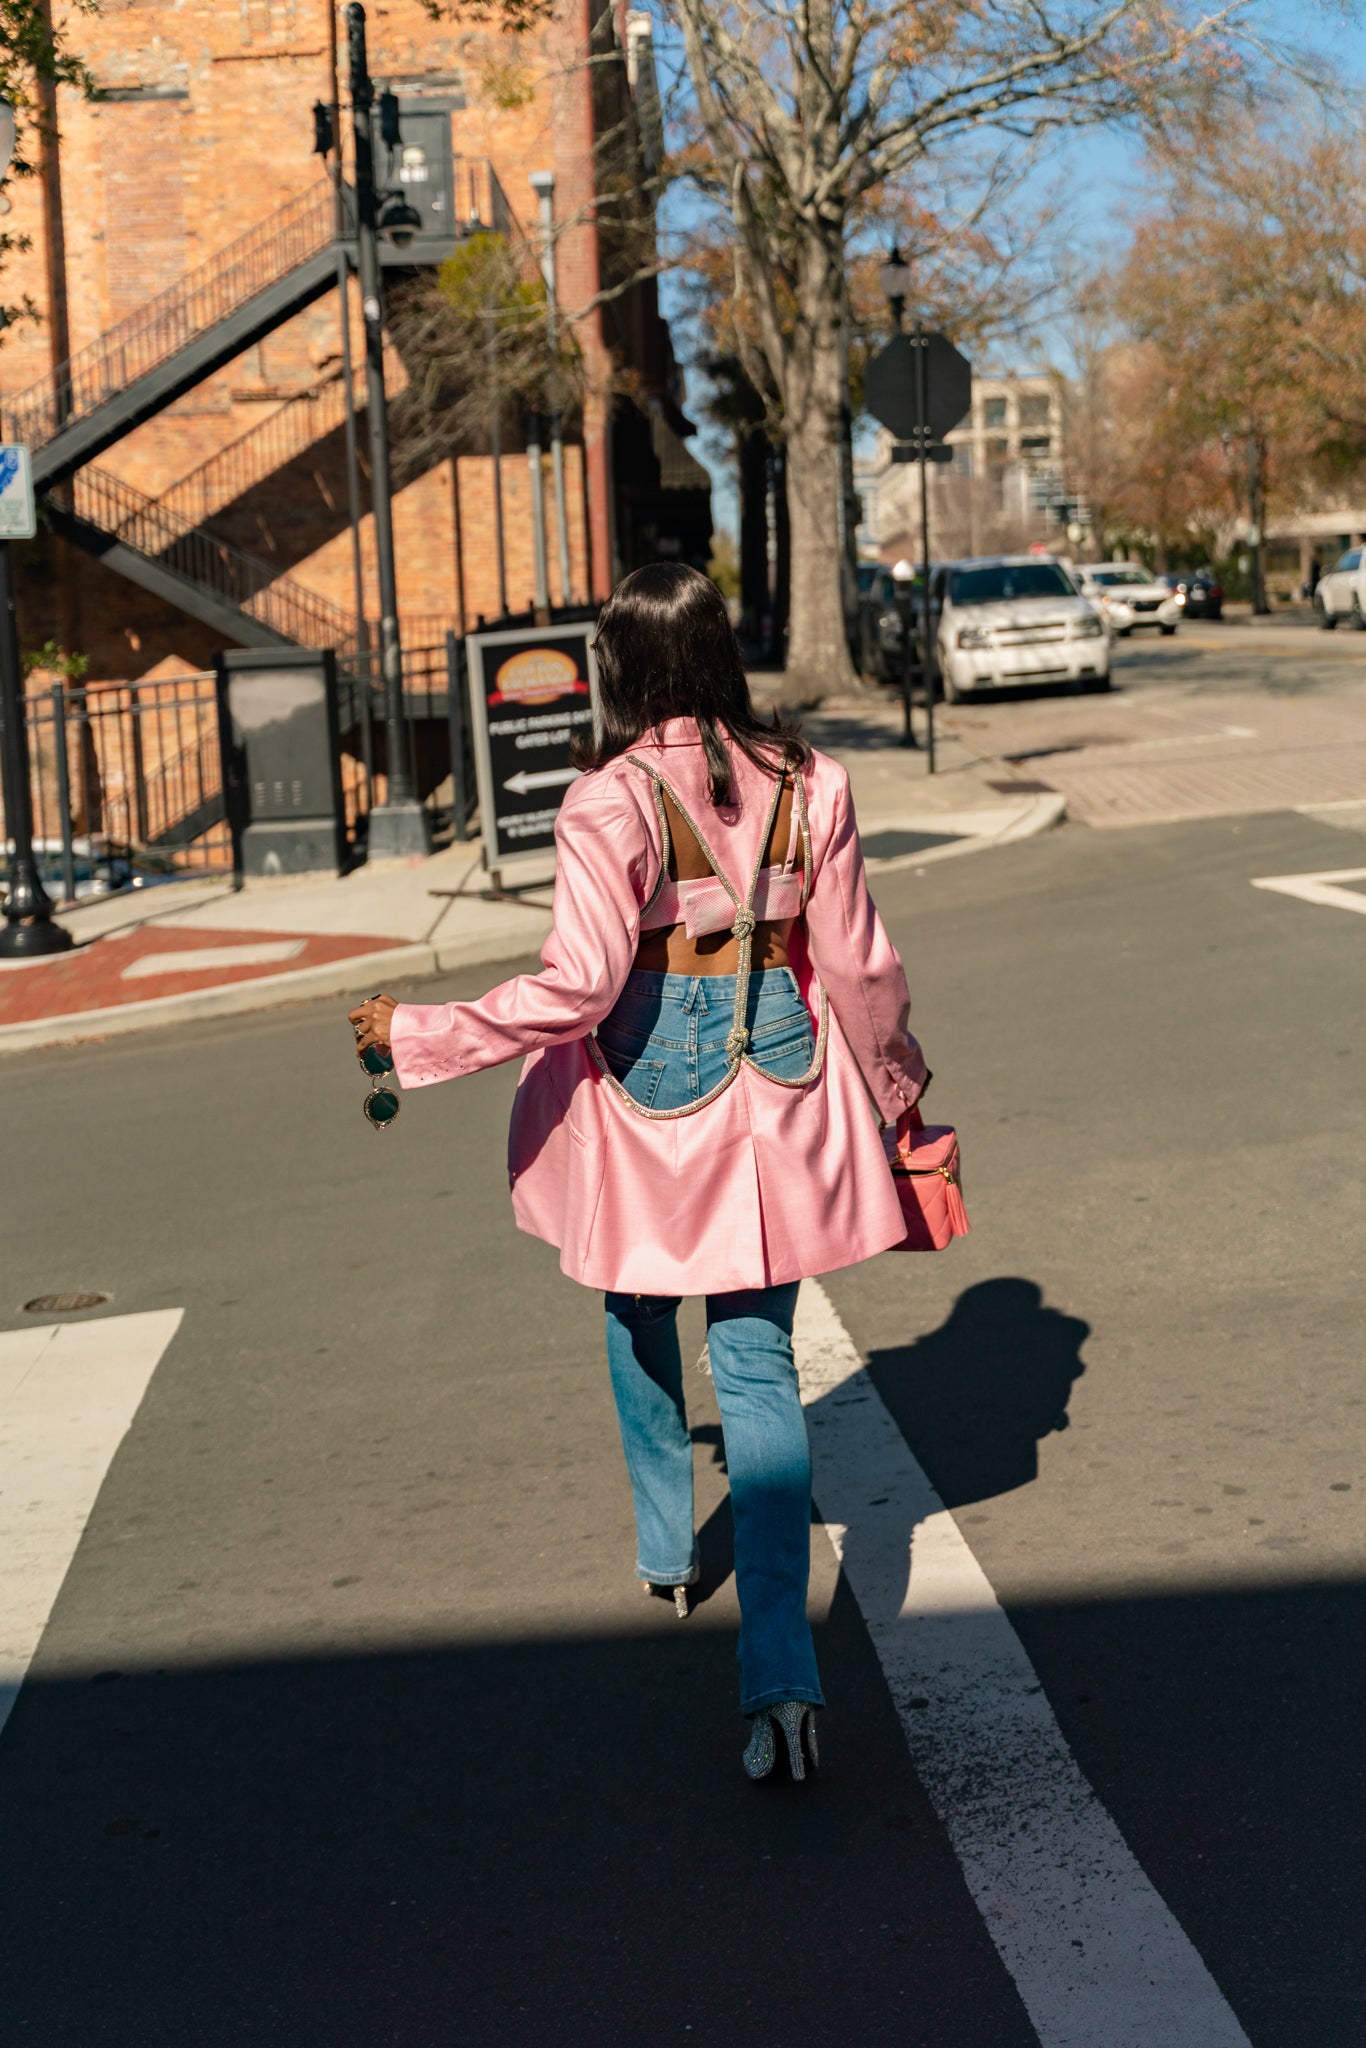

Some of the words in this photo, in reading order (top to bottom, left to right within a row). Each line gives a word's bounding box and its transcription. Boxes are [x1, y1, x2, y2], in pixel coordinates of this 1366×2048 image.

[489, 718, 527, 736] PUBLIC
[528, 711, 571, 730] PARKING
[515, 731, 549, 749] GATED
[550, 728, 571, 744] LOT
